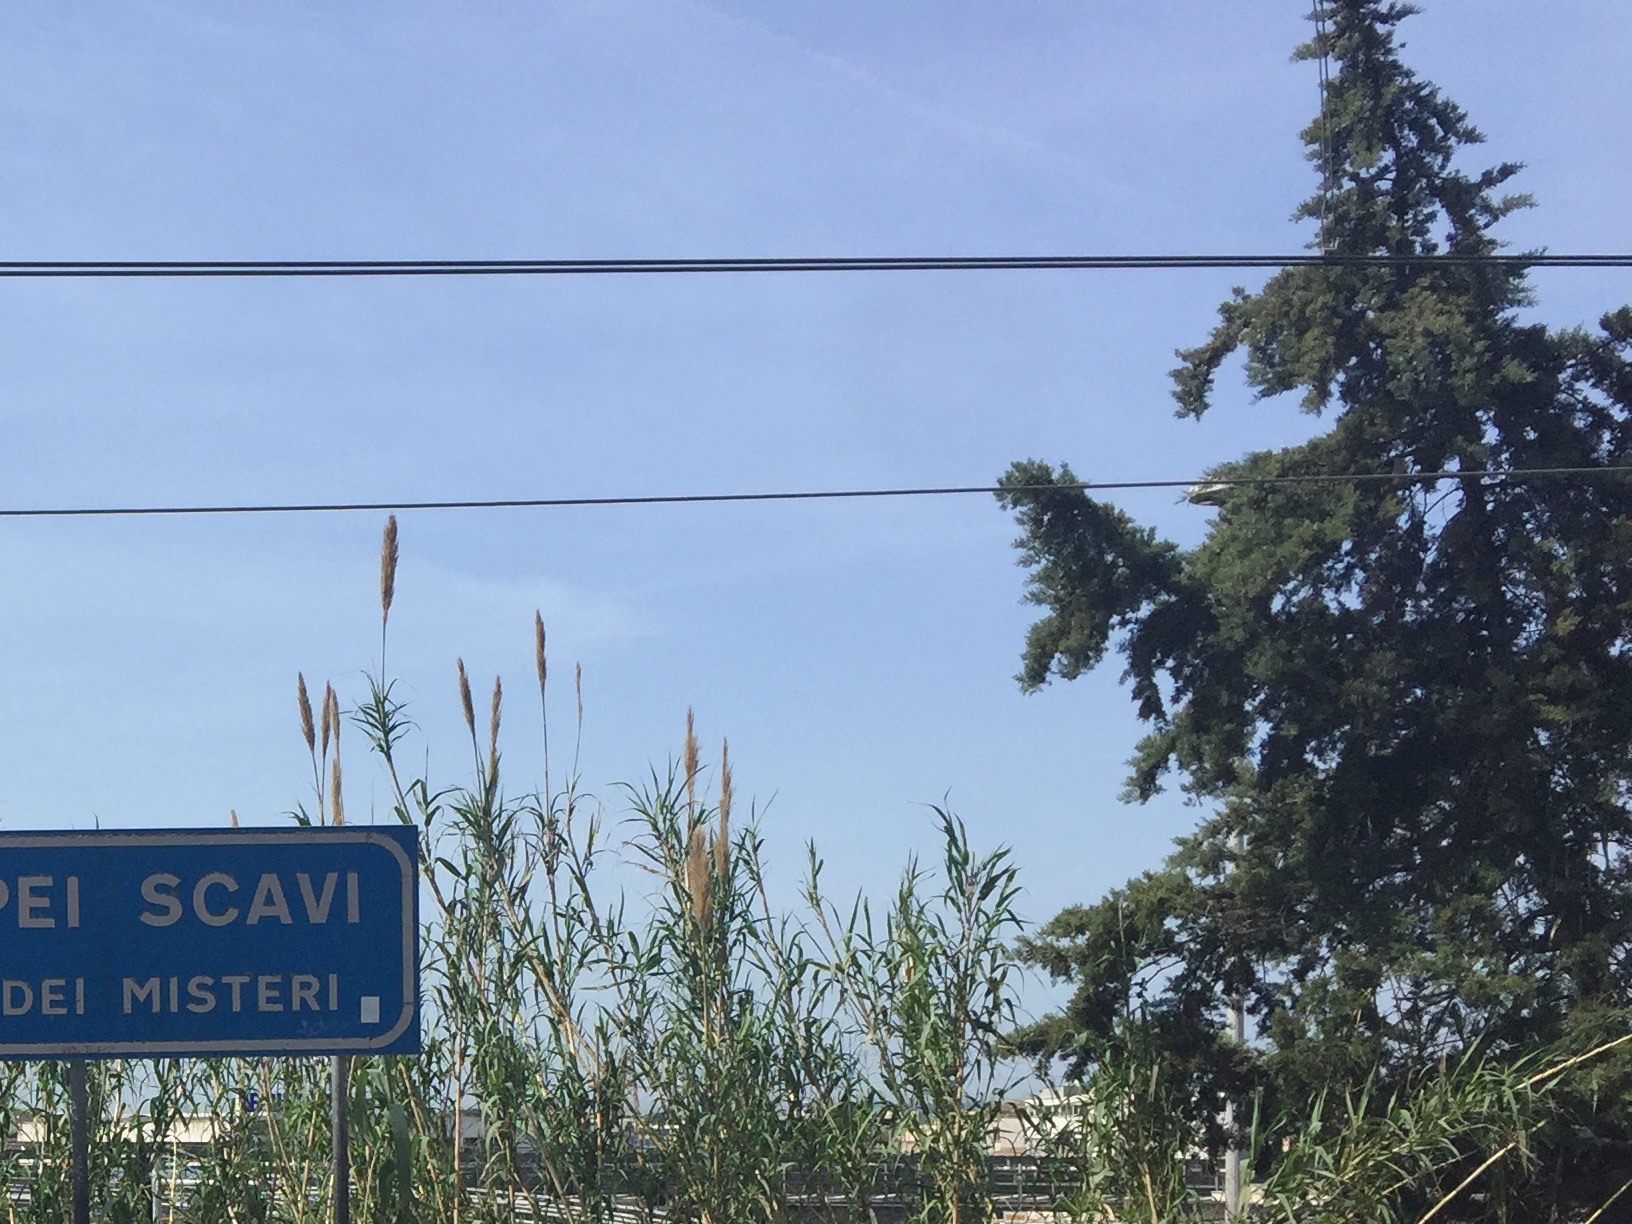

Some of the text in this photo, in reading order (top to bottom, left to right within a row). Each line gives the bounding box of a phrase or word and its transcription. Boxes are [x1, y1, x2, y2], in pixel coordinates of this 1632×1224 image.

[139, 872, 359, 927] SCAVI
[2, 978, 85, 1016] DEI
[123, 973, 338, 1014] MISTERI
